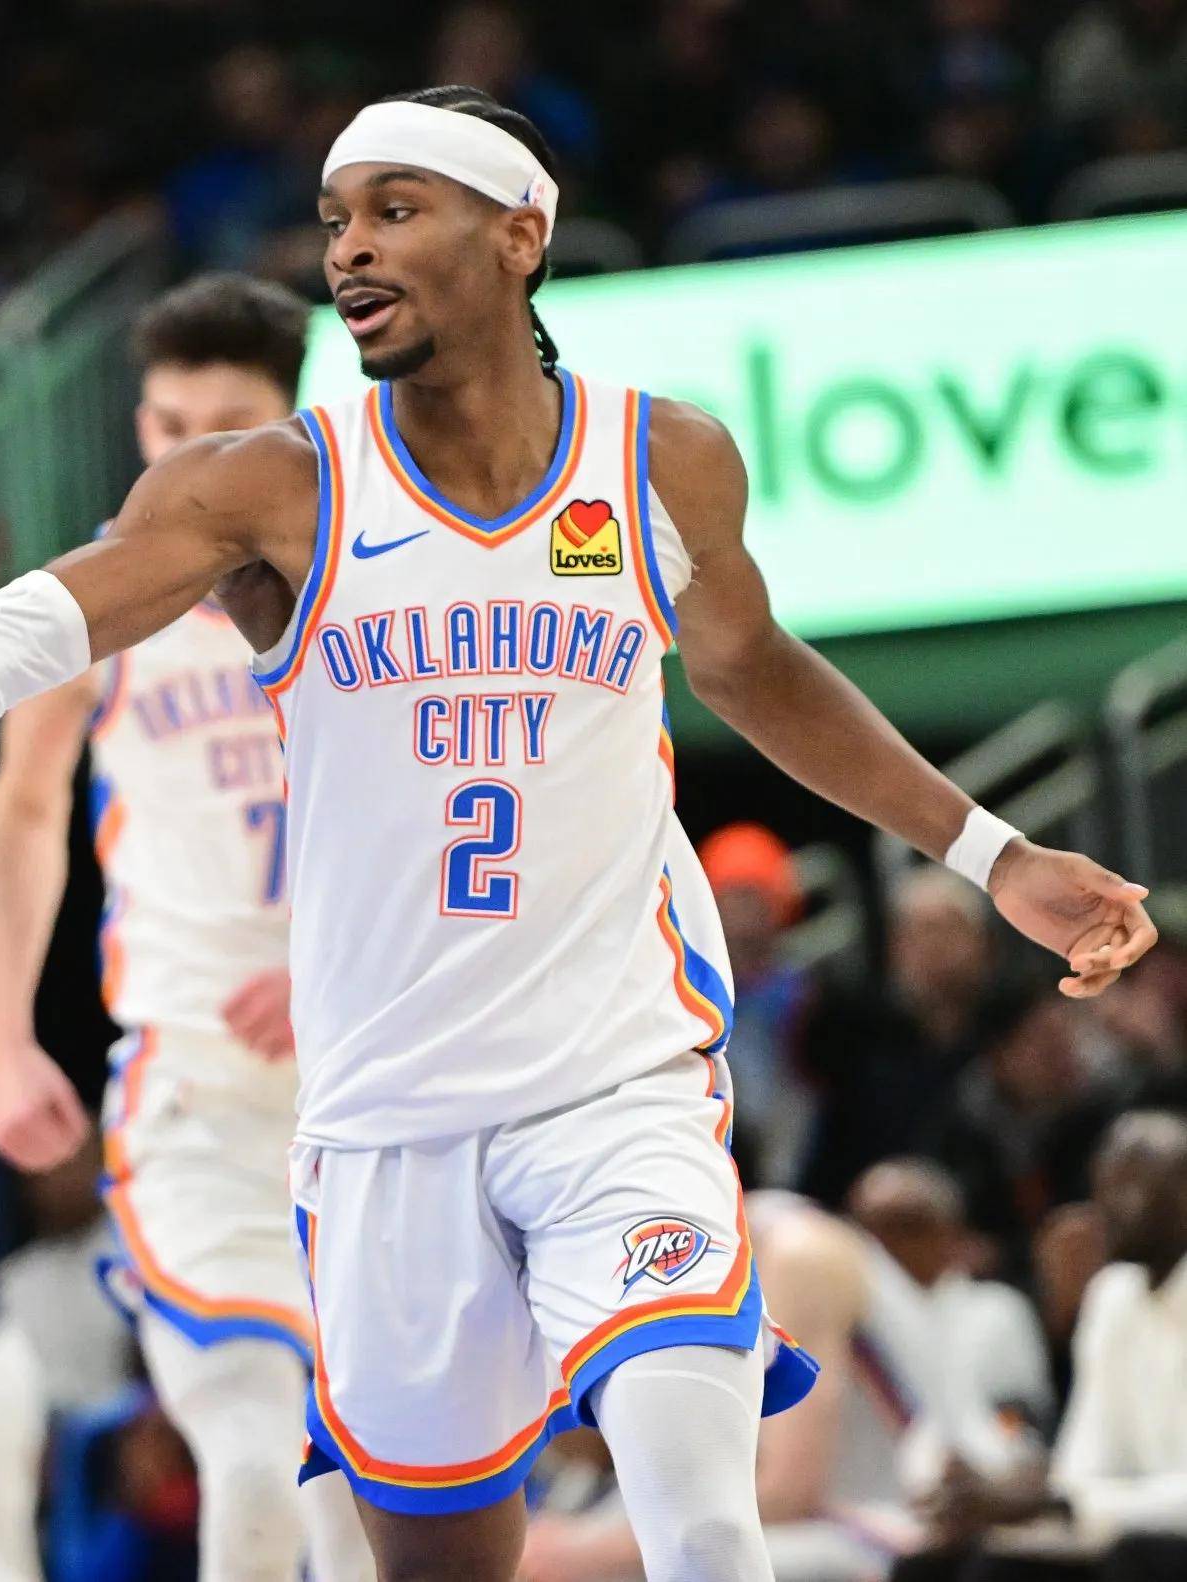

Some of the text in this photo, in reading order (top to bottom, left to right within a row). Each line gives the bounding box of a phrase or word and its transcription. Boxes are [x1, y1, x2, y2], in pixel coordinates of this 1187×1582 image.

[317, 601, 648, 694] OKLAHOMA
[414, 692, 555, 766] CITY
[440, 778, 522, 919] 2
[623, 1230, 692, 1284] OKC
